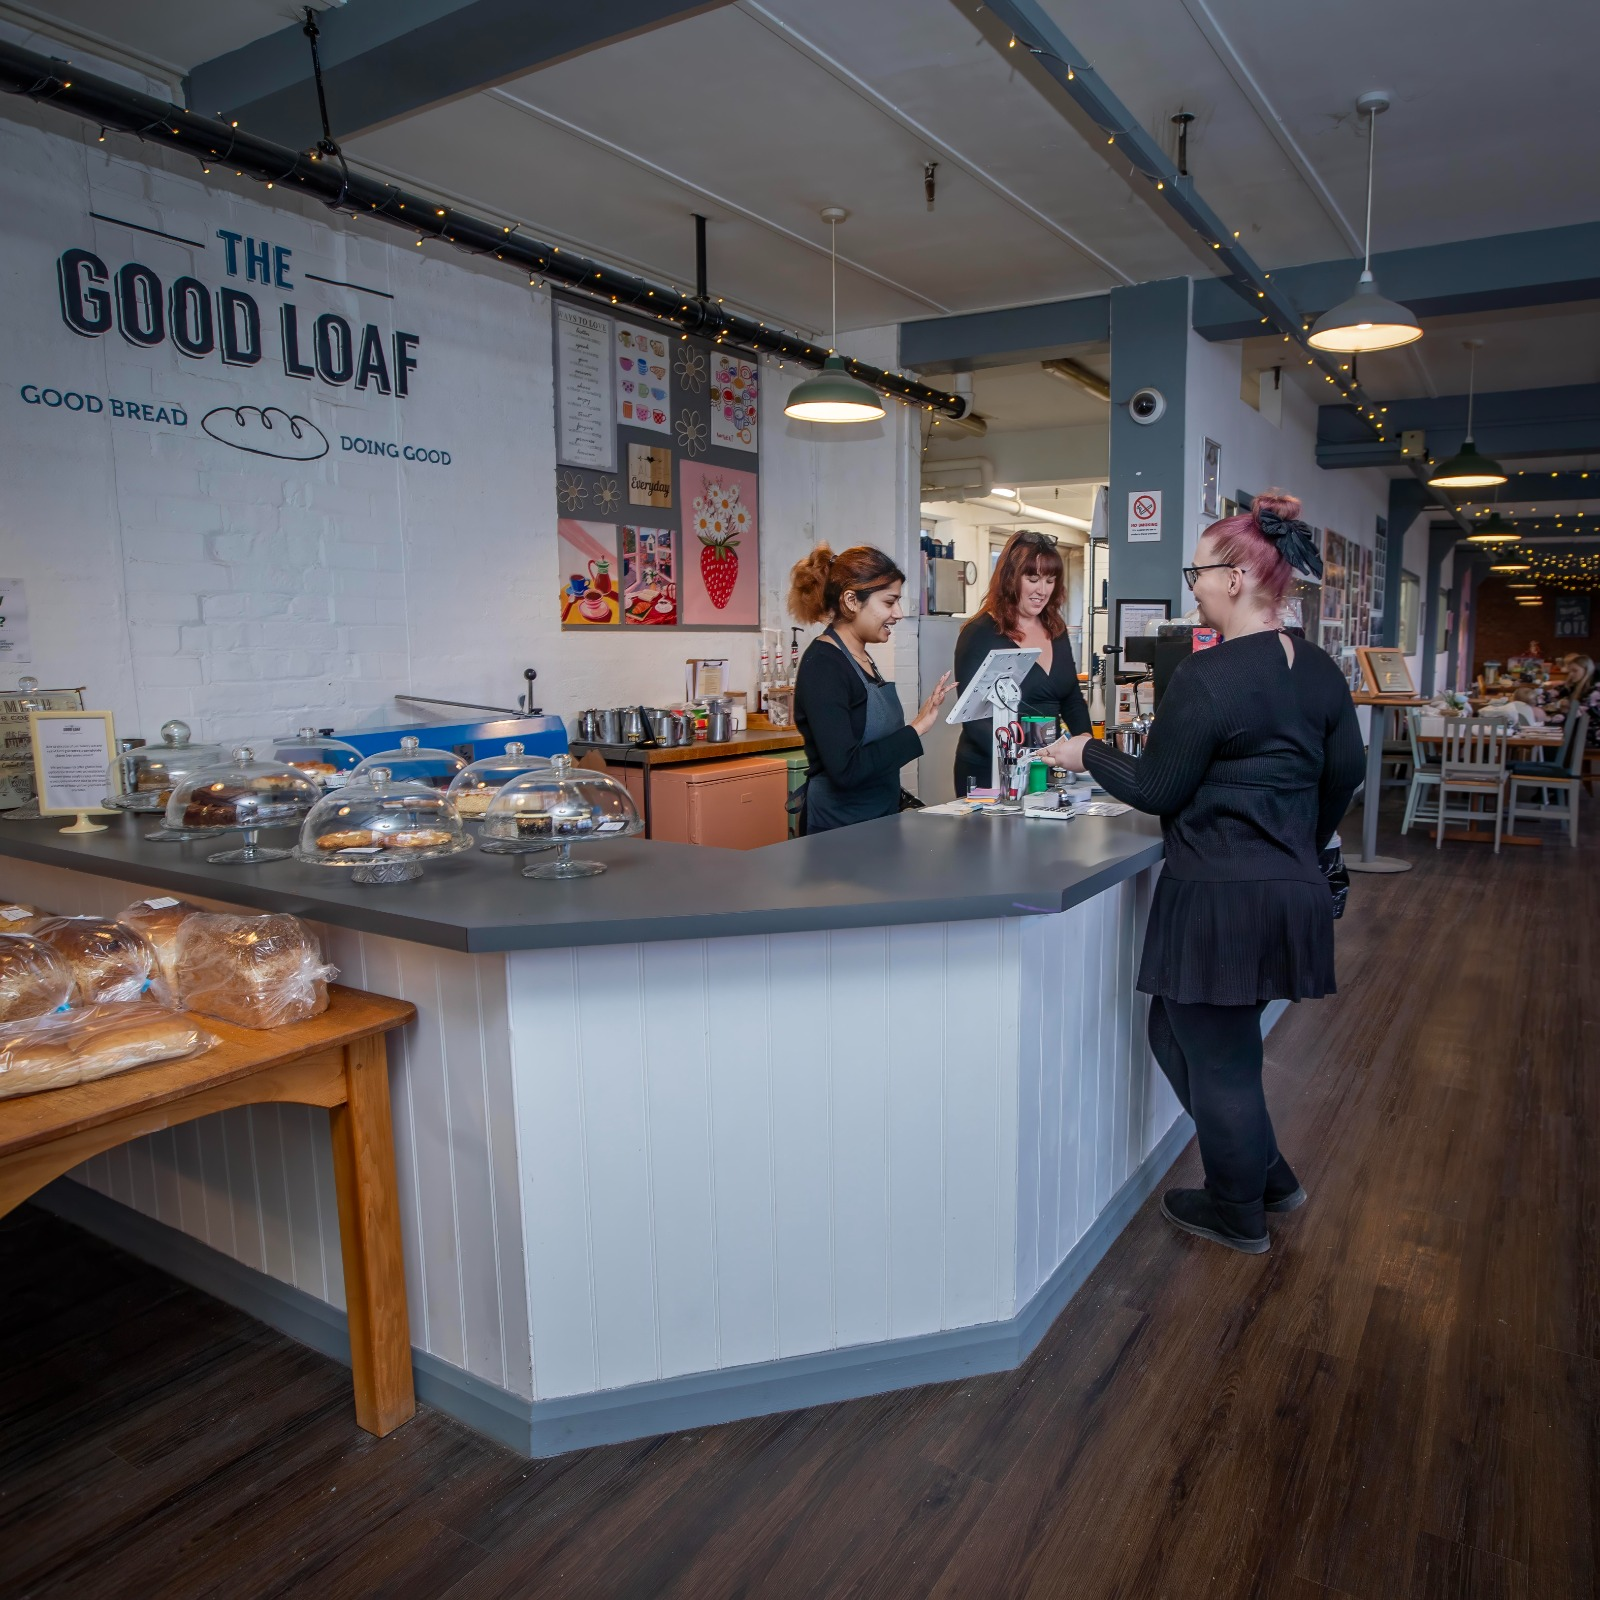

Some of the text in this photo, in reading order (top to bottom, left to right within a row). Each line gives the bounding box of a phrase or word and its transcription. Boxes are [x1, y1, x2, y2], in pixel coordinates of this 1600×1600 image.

[216, 229, 294, 291] THE
[56, 248, 420, 399] GOOD LOAF
[578, 316, 588, 326] TO
[589, 319, 607, 332] LOVE
[20, 385, 188, 426] GOOD BREAD
[340, 436, 452, 465] DOING GOOD
[631, 476, 670, 498] Everyday
